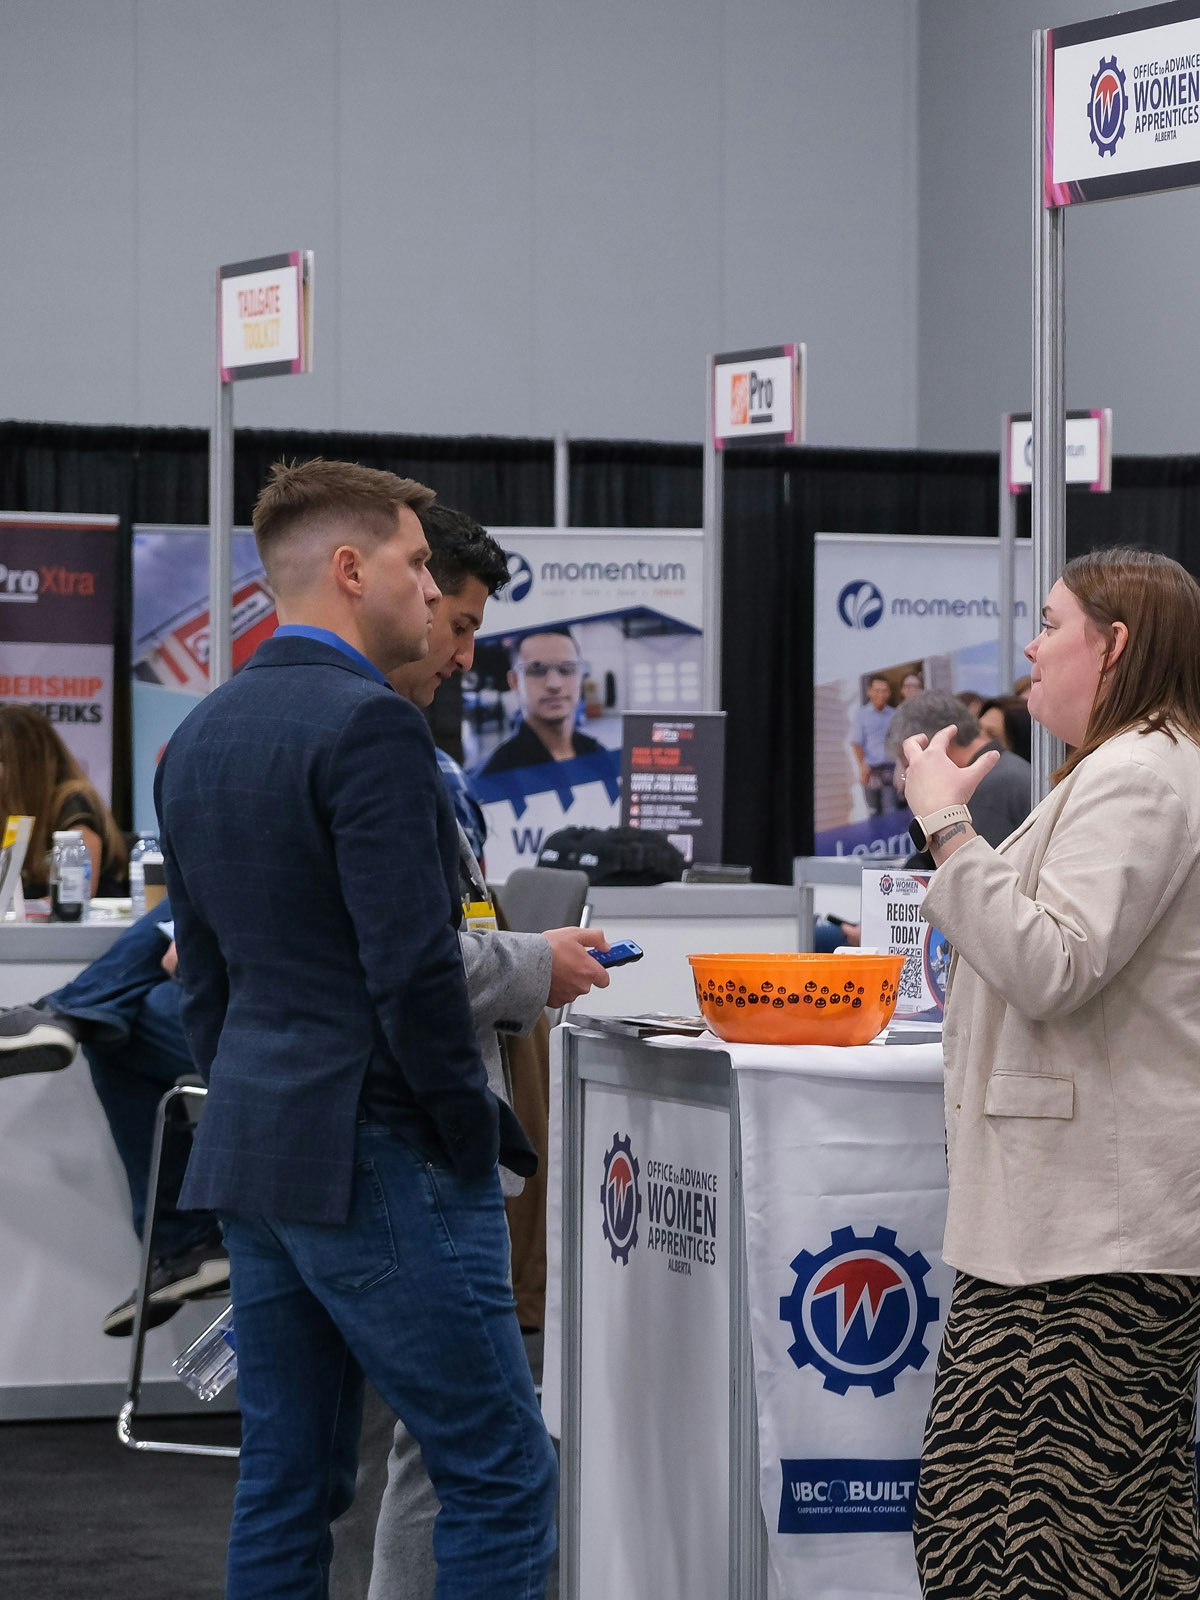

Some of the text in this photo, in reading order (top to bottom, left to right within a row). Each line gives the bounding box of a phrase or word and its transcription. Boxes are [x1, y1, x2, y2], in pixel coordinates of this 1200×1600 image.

[1133, 53, 1200, 80] OFFICE to ADVANCE
[1133, 70, 1200, 113] WOMEN
[1134, 104, 1199, 134] APPRENTICES
[1154, 129, 1177, 143] ALBERTA
[750, 371, 774, 410] Pro
[541, 559, 687, 582] momentum
[895, 881, 919, 889] WOMEN
[887, 903, 926, 923] REGIST
[891, 925, 921, 945] TODAY
[647, 1160, 718, 1193] OFFICE to ADVANCE
[647, 1181, 717, 1239] WOMEN
[647, 1226, 716, 1266] APPRENTICES
[667, 1258, 692, 1276] ALBERTA
[791, 1481, 915, 1502] UBC BUILT
